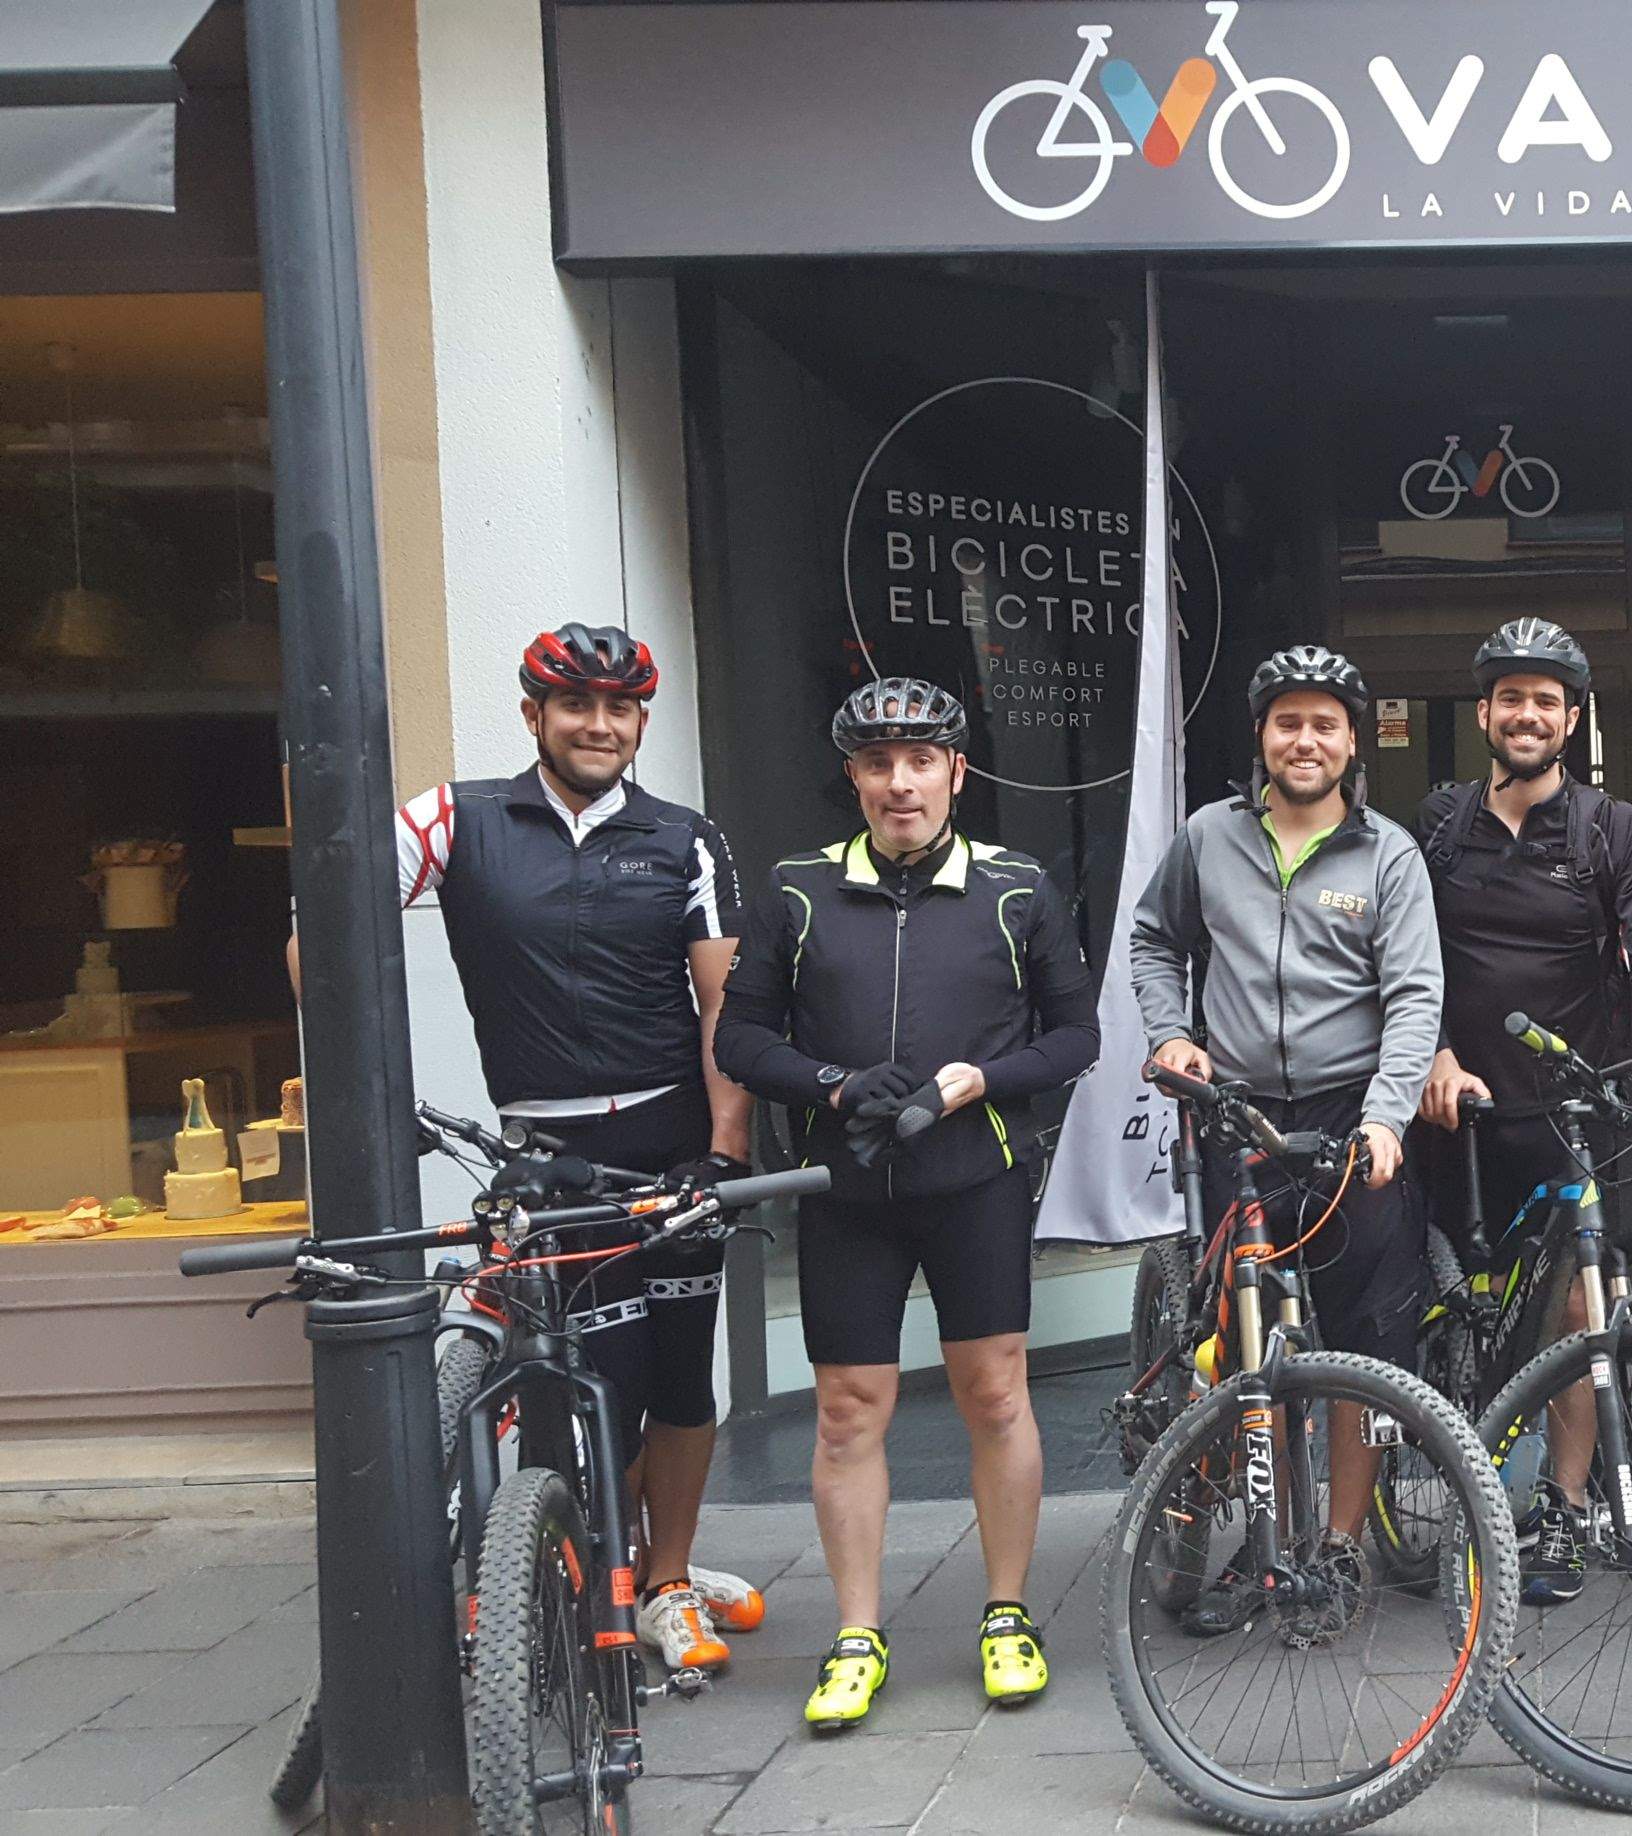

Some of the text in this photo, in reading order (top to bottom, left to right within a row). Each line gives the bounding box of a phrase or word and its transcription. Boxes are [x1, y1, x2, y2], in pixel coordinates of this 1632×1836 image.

[1383, 193, 1443, 217] LA
[1494, 190, 1632, 216] VIDA
[886, 489, 1129, 535] ESPECIALISTES
[988, 657, 1105, 678] PLEGABLE
[992, 683, 1104, 703] COMFORT
[1007, 711, 1093, 728] ESPORT
[619, 861, 654, 871] GORE
[1318, 889, 1368, 913] BEST
[1246, 1432, 1276, 1524] FOX
